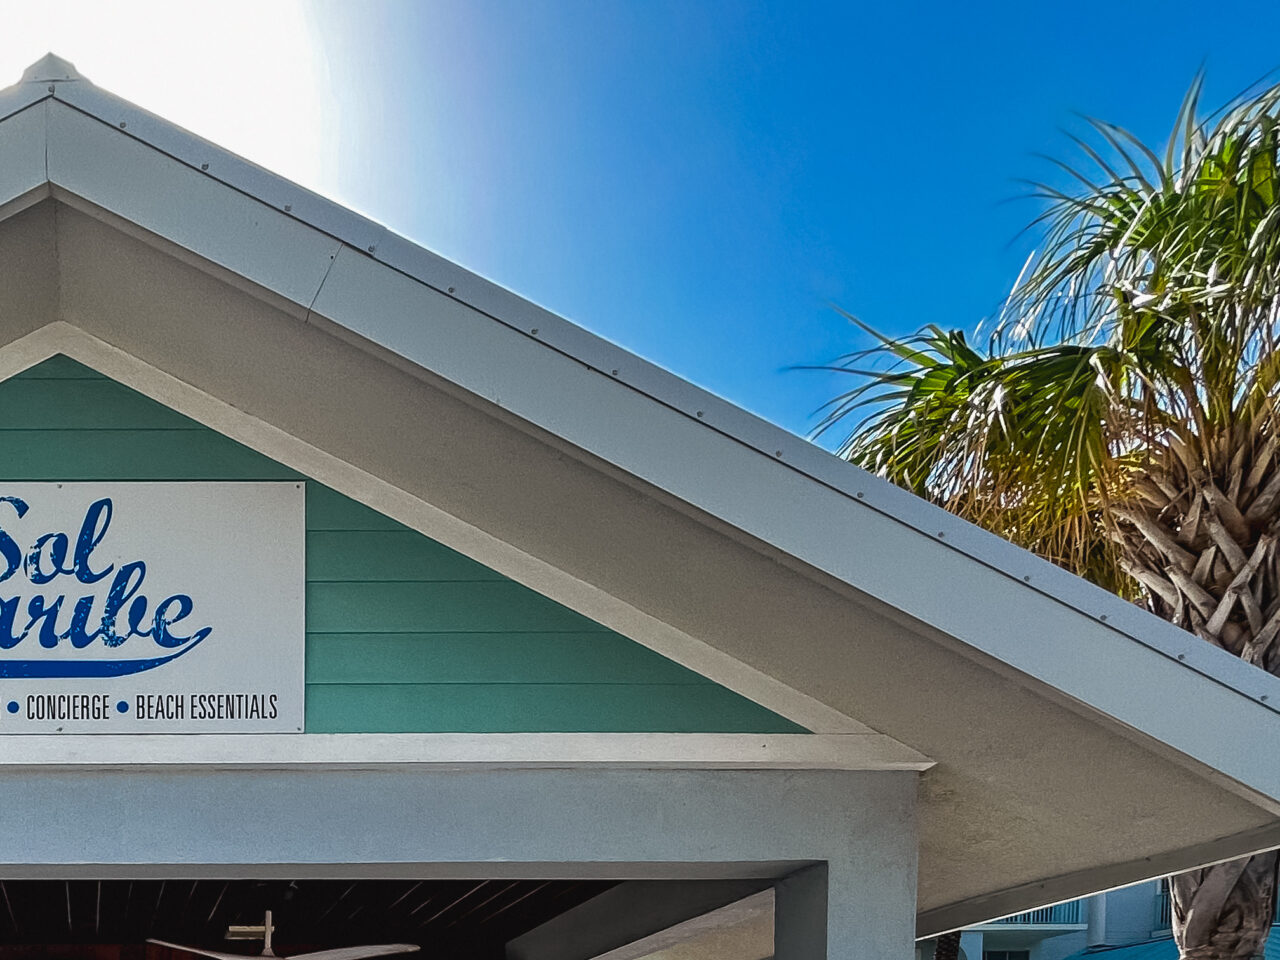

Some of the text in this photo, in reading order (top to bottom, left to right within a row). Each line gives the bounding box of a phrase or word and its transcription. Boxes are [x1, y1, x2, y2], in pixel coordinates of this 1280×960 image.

[26, 695, 110, 720] CONCIERGE
[136, 694, 185, 719] BEACH
[190, 694, 278, 719] ESSENTIALS
